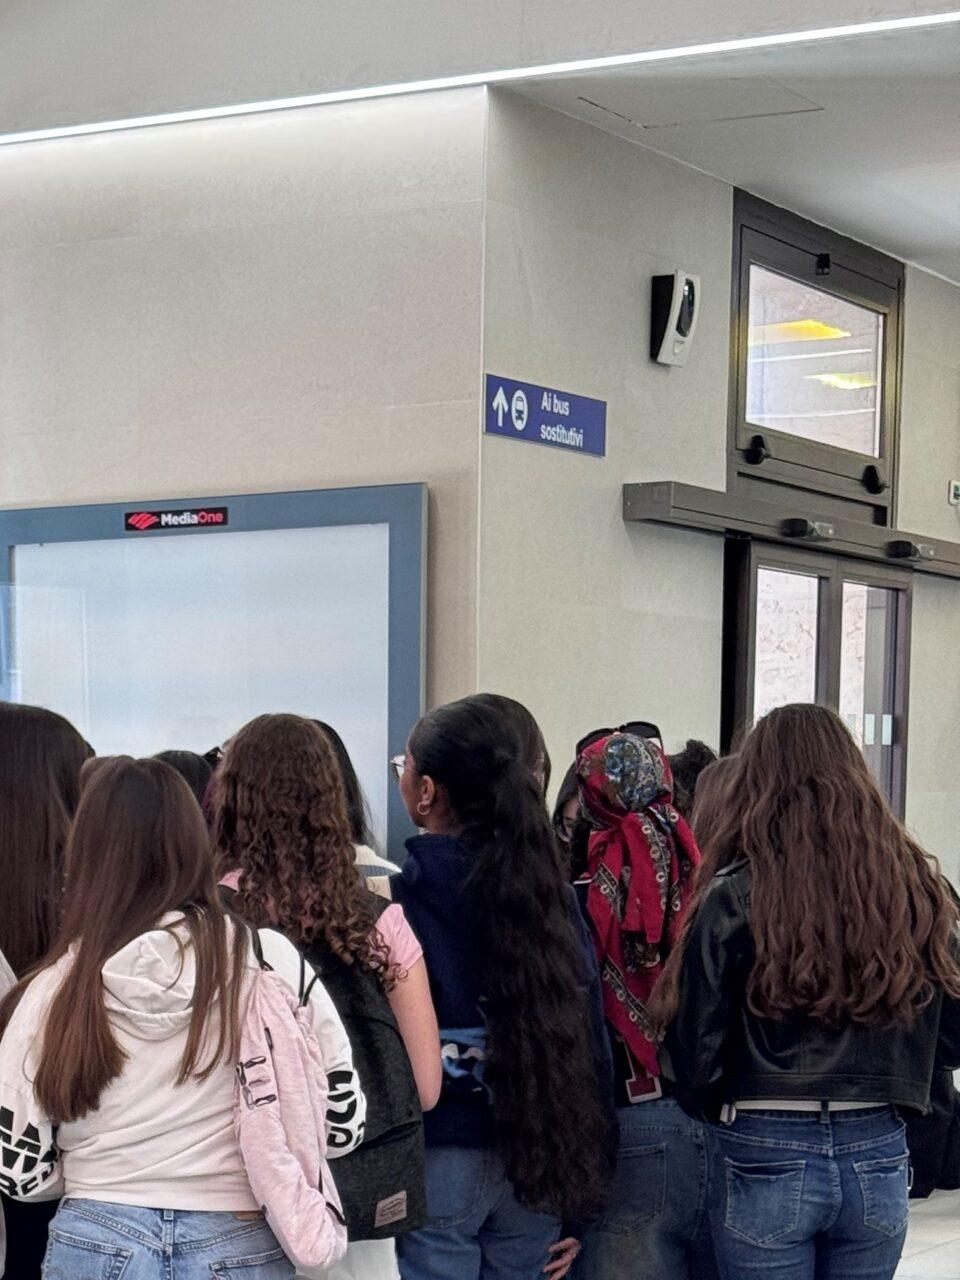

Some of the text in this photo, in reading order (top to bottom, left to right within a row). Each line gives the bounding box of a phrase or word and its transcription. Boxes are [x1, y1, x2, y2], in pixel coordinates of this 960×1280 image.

[541, 392, 569, 415] Ai bus
[540, 424, 583, 447] sostitutivi
[161, 511, 224, 526] MediaOne
